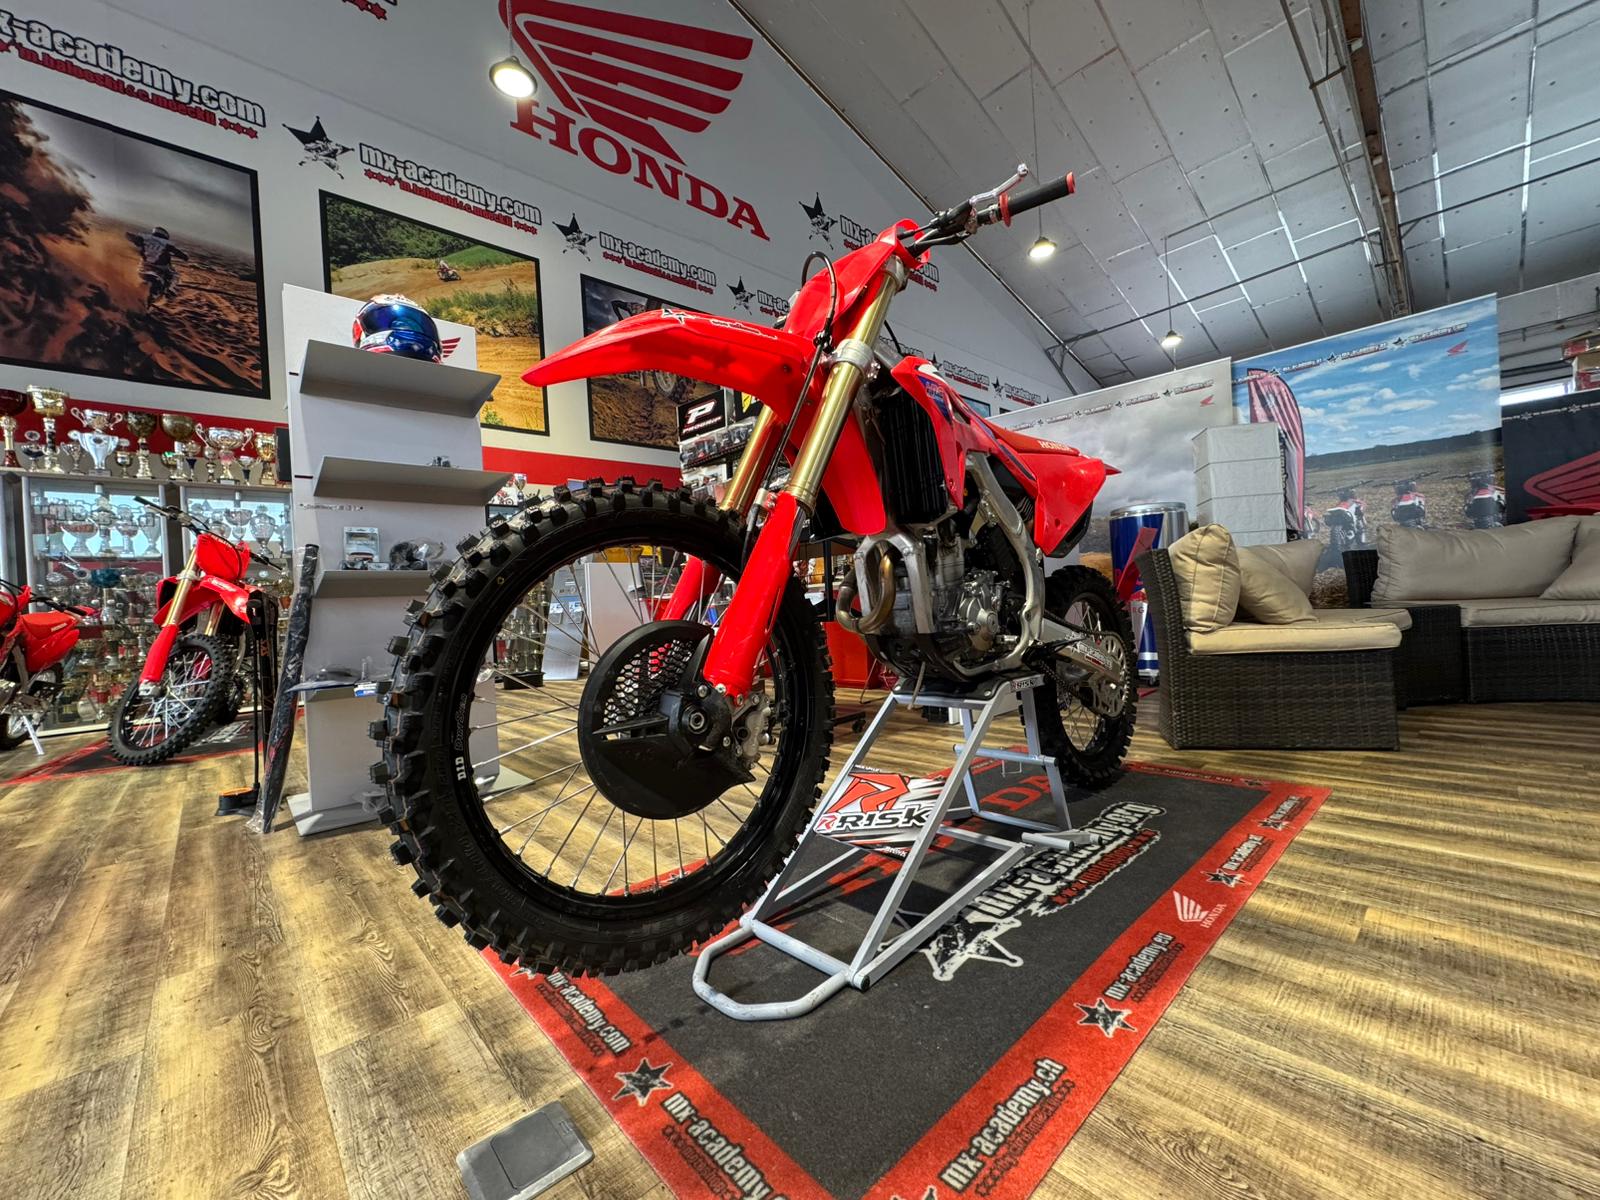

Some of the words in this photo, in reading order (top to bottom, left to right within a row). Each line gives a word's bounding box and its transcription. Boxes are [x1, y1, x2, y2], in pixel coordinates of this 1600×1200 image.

[0, 8, 266, 128] x-academy.com
[359, 142, 542, 226] mx-academy.com
[510, 98, 770, 242] HONDA
[599, 231, 717, 287] mx-academy.com
[455, 756, 467, 781] DID
[838, 806, 930, 828] RISK
[1200, 903, 1227, 929] HONDA
[1104, 931, 1176, 1001] mx-academy.eu
[546, 971, 632, 1055] mx-academy.com
[661, 1091, 787, 1200] mx-academy
[940, 1057, 1067, 1193] mx-academy.ch
